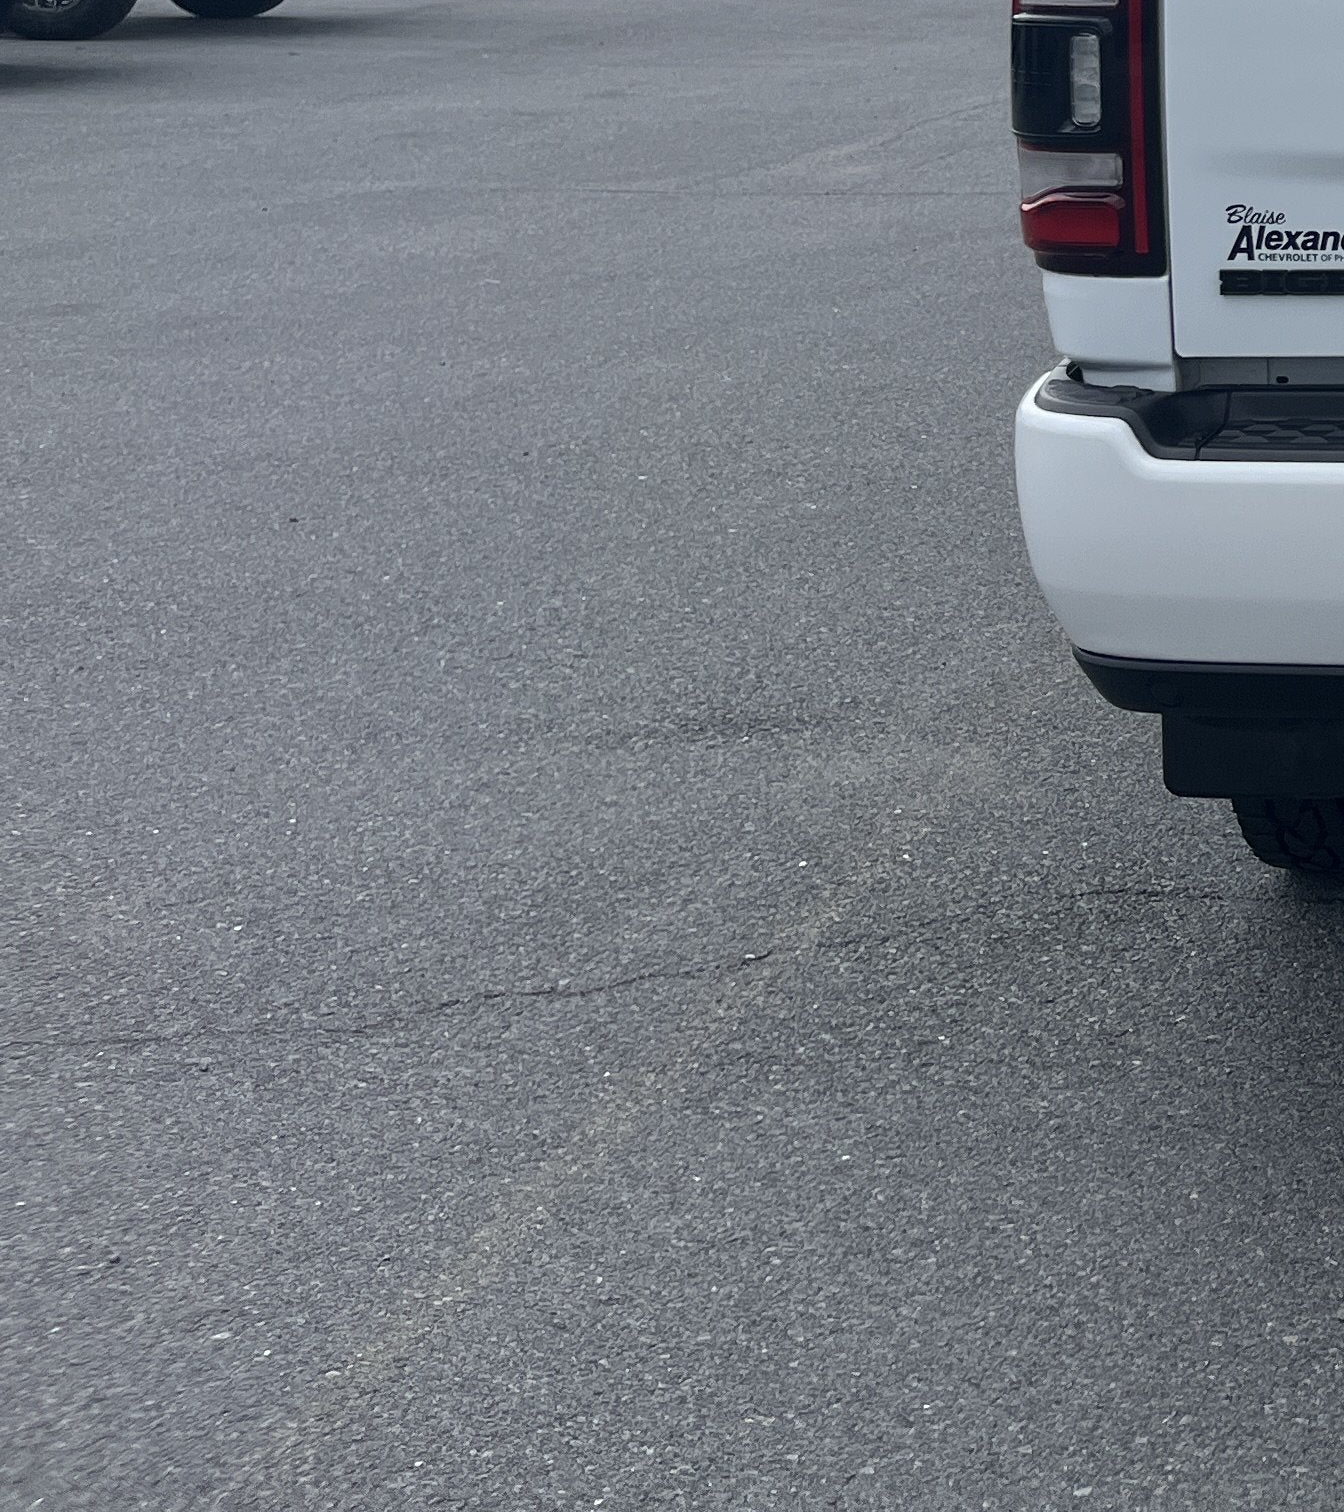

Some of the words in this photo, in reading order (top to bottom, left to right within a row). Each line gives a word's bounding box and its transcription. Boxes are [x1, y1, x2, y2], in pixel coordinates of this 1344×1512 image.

[1225, 204, 1286, 225] Blaise
[1257, 252, 1318, 262] CHEVROLET
[1320, 253, 1333, 262] OF
